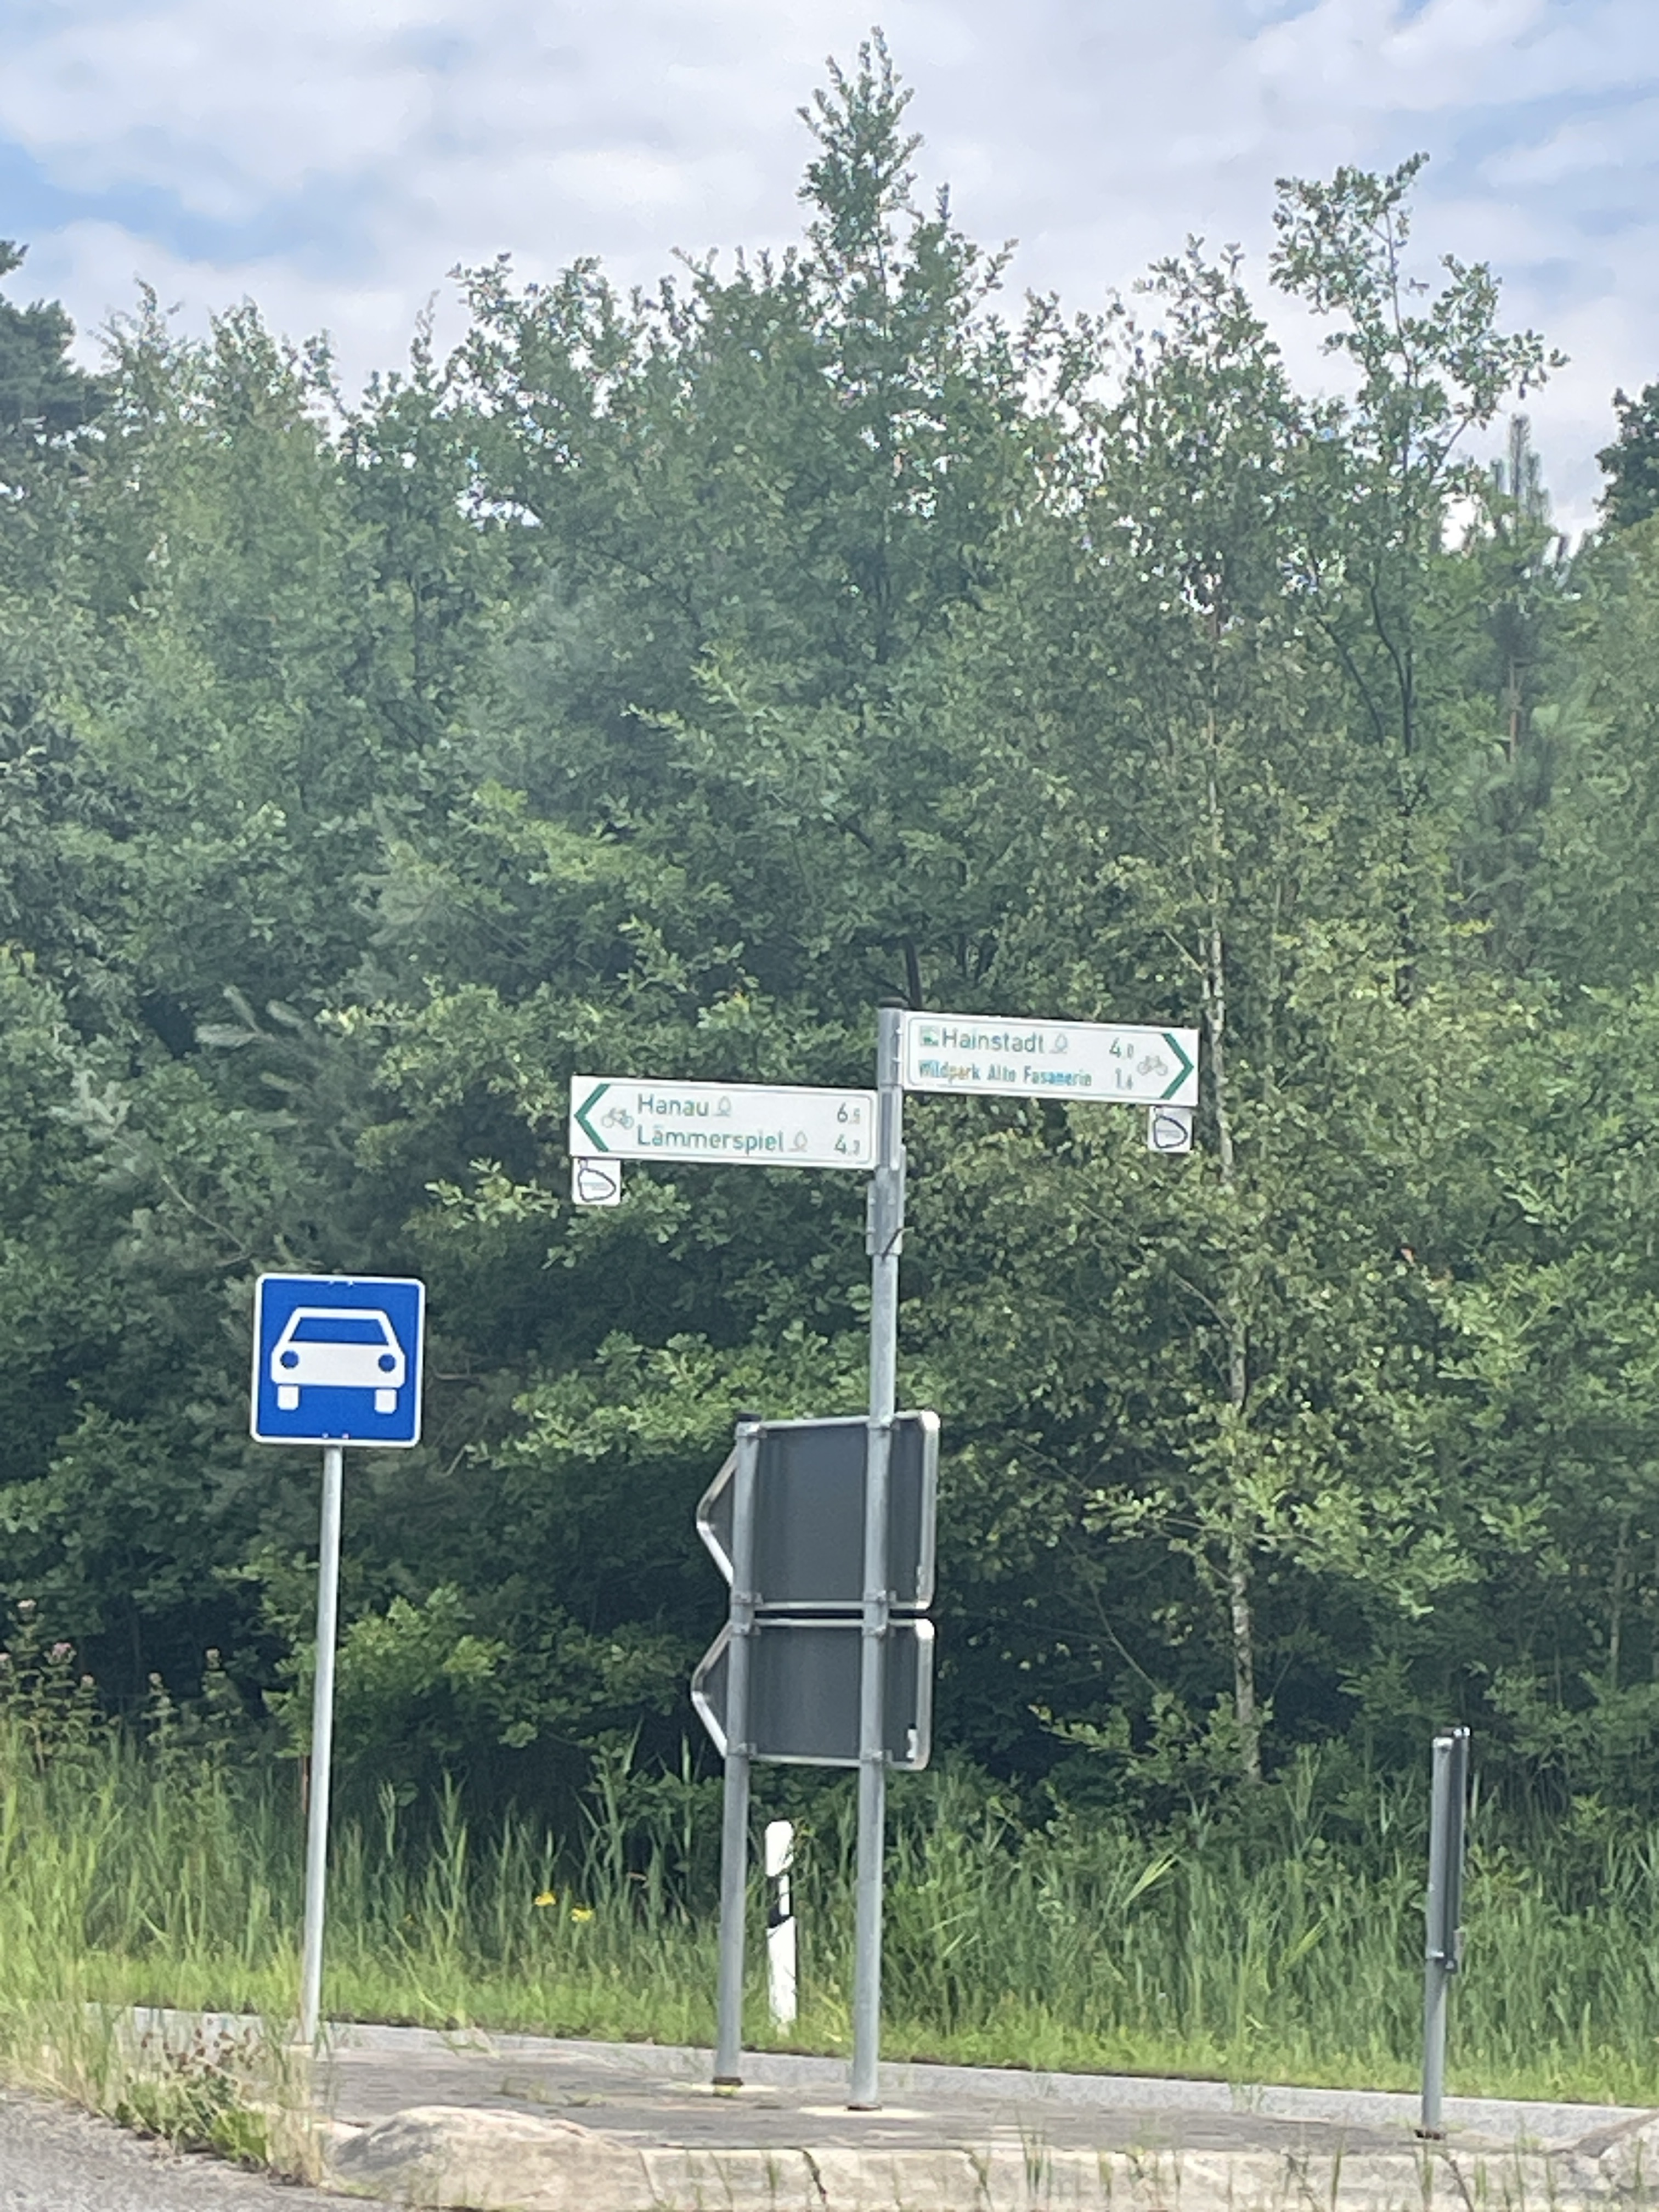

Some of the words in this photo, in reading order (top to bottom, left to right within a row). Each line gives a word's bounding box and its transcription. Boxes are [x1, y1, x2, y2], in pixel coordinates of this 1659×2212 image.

[942, 1028, 1044, 1053] Hainstadt
[637, 1093, 709, 1116] Hanau
[637, 1125, 783, 1156] Lämmerspiel
